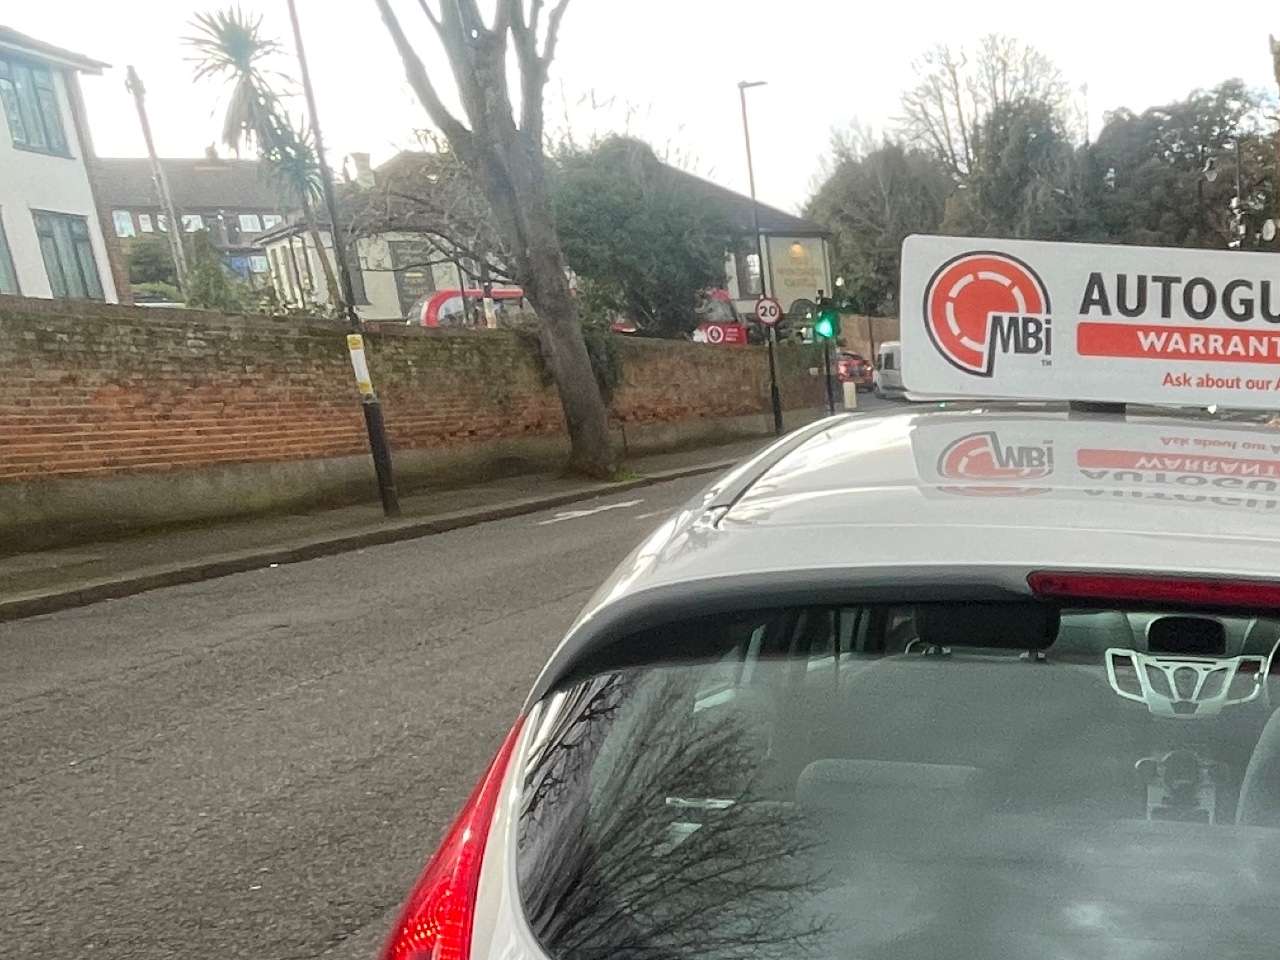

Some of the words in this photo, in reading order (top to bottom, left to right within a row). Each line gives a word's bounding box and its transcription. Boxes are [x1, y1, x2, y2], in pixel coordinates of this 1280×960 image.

[759, 305, 778, 317] 20
[989, 315, 1052, 356] MBi
[1162, 372, 1191, 387] Ask
[1197, 374, 1241, 389] about
[1242, 378, 1271, 390] our
